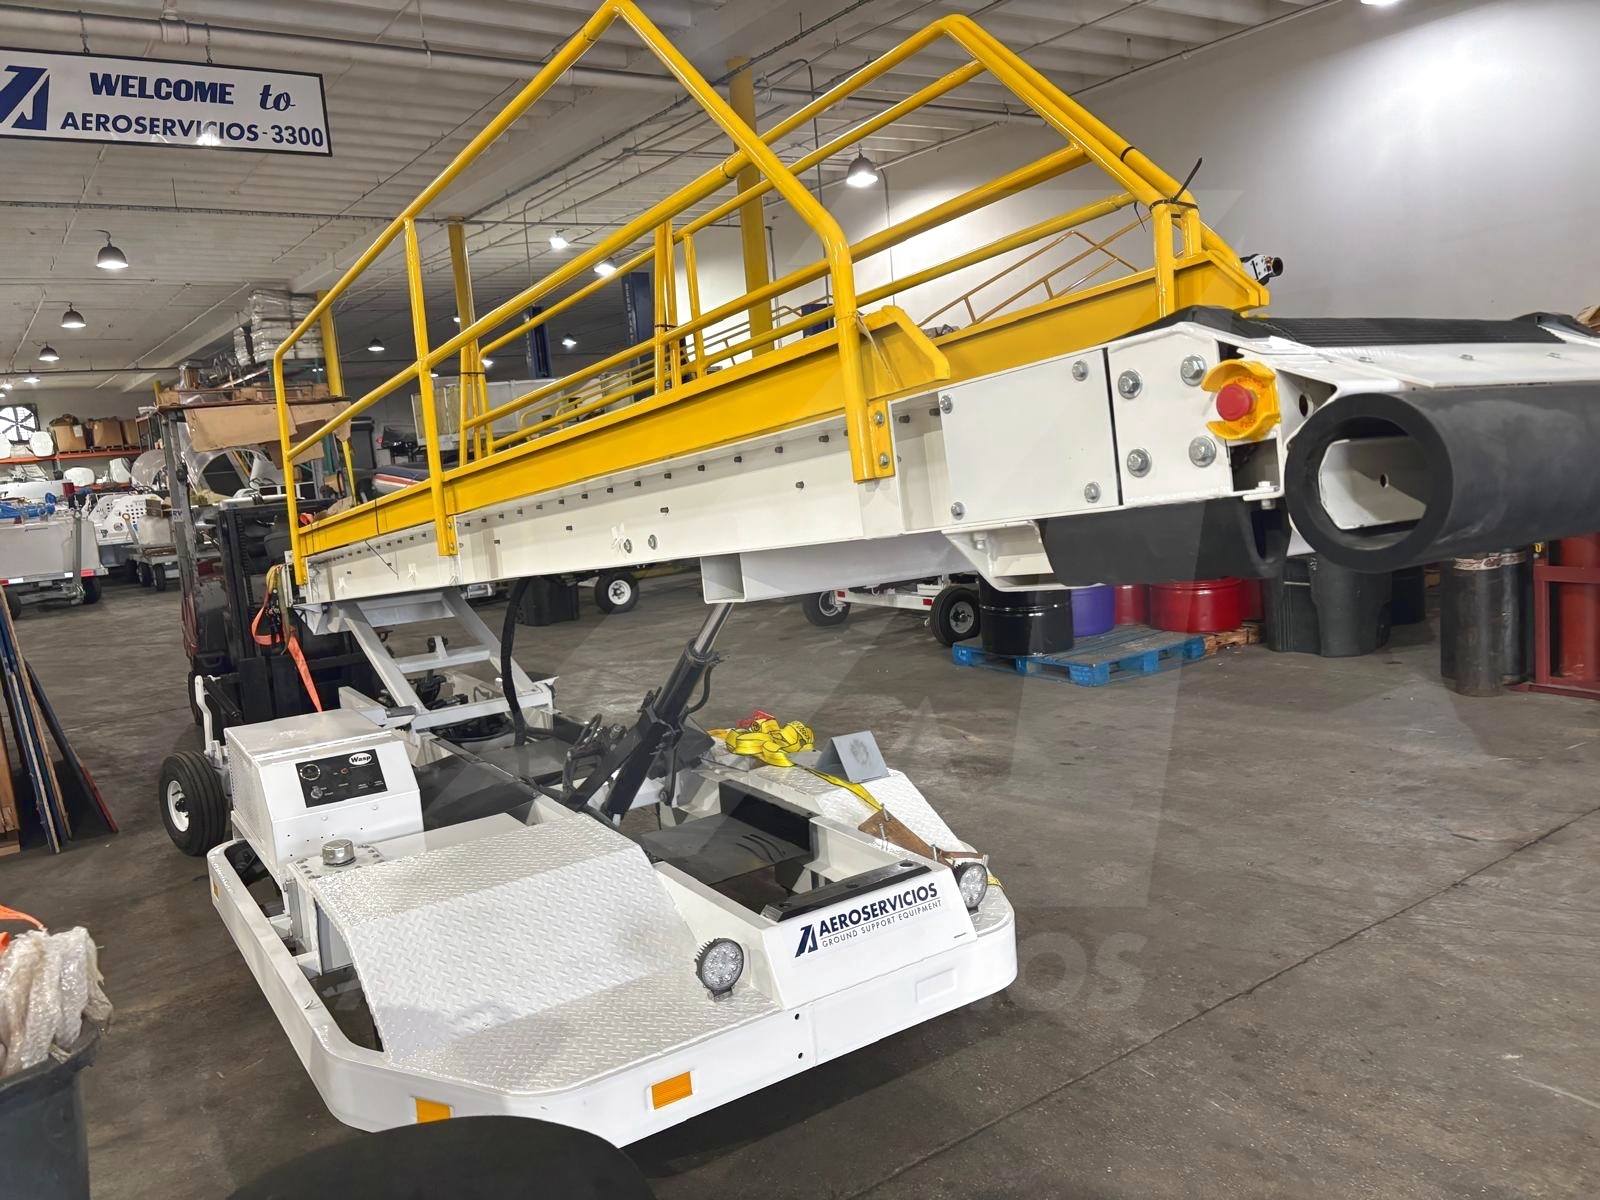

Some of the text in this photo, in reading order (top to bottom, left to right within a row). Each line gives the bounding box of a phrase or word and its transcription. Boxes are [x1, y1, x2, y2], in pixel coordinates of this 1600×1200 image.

[89, 72, 296, 111] WELCOME to
[351, 755, 371, 763] Wasp
[819, 882, 938, 937] AEROSERVICIOS
[822, 900, 942, 948] GROUND SUPPORT EQUIPMENT
